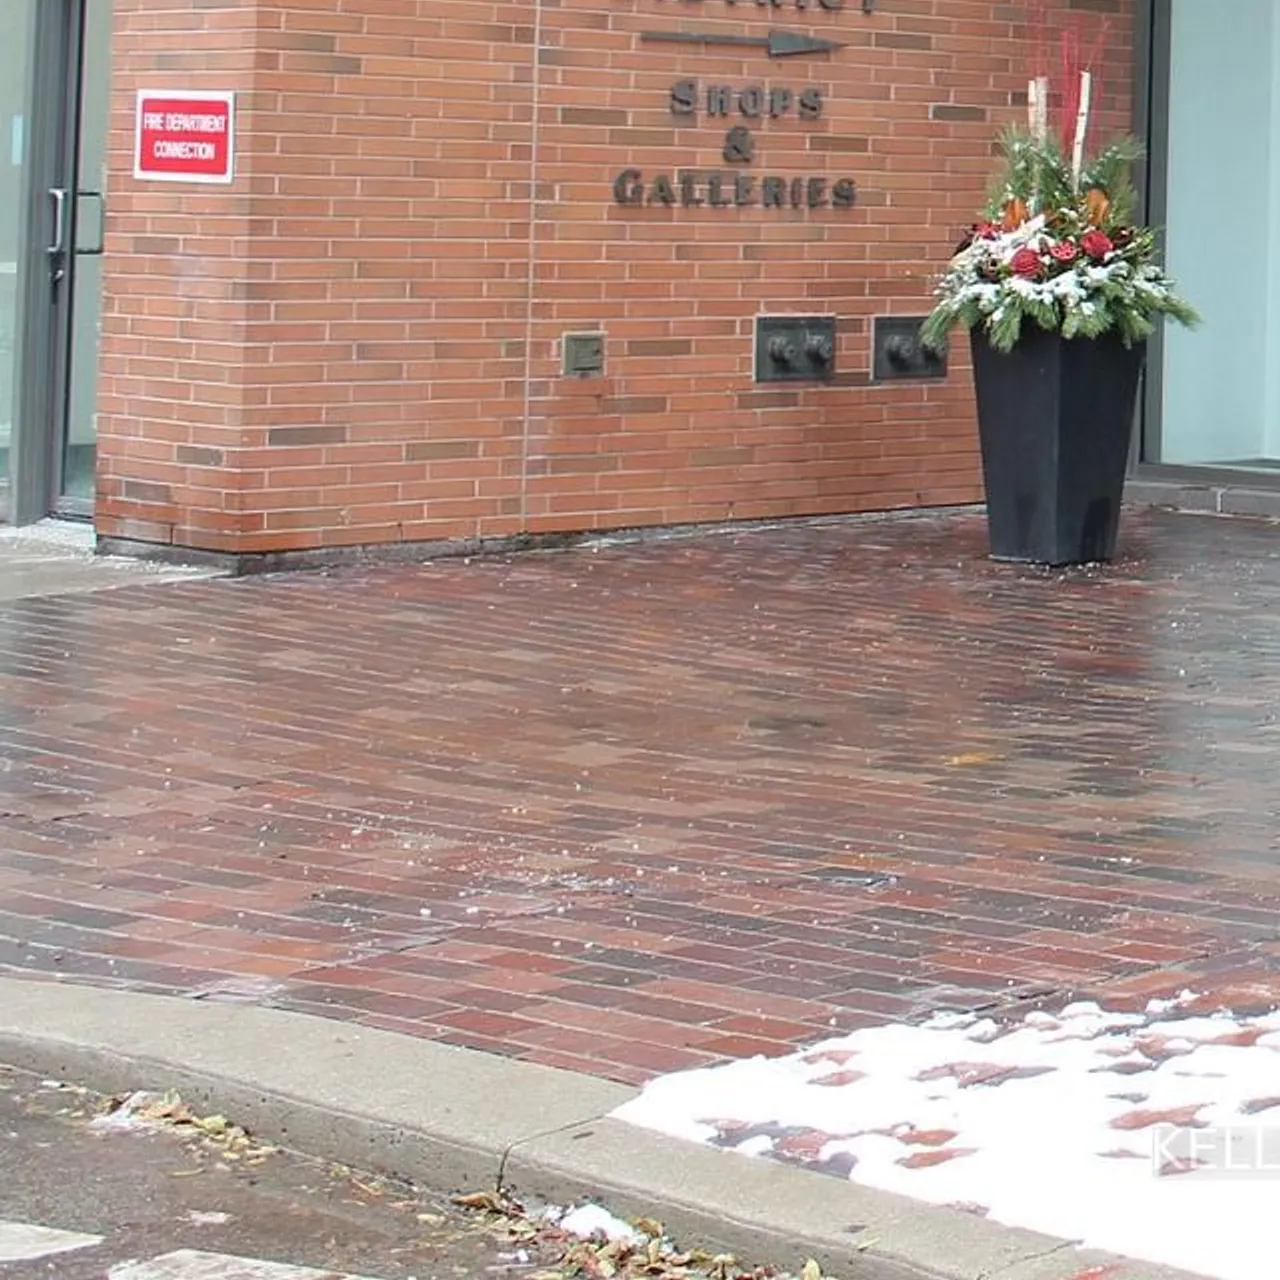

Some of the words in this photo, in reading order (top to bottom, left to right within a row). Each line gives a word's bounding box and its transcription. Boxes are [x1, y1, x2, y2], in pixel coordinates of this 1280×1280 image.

[670, 79, 825, 120] SHOPS
[144, 112, 164, 130] FIRE
[166, 113, 225, 133] DEPARTMENT
[154, 141, 215, 160] CONNECTION
[722, 126, 755, 164] &
[613, 168, 857, 210] GALLERIES
